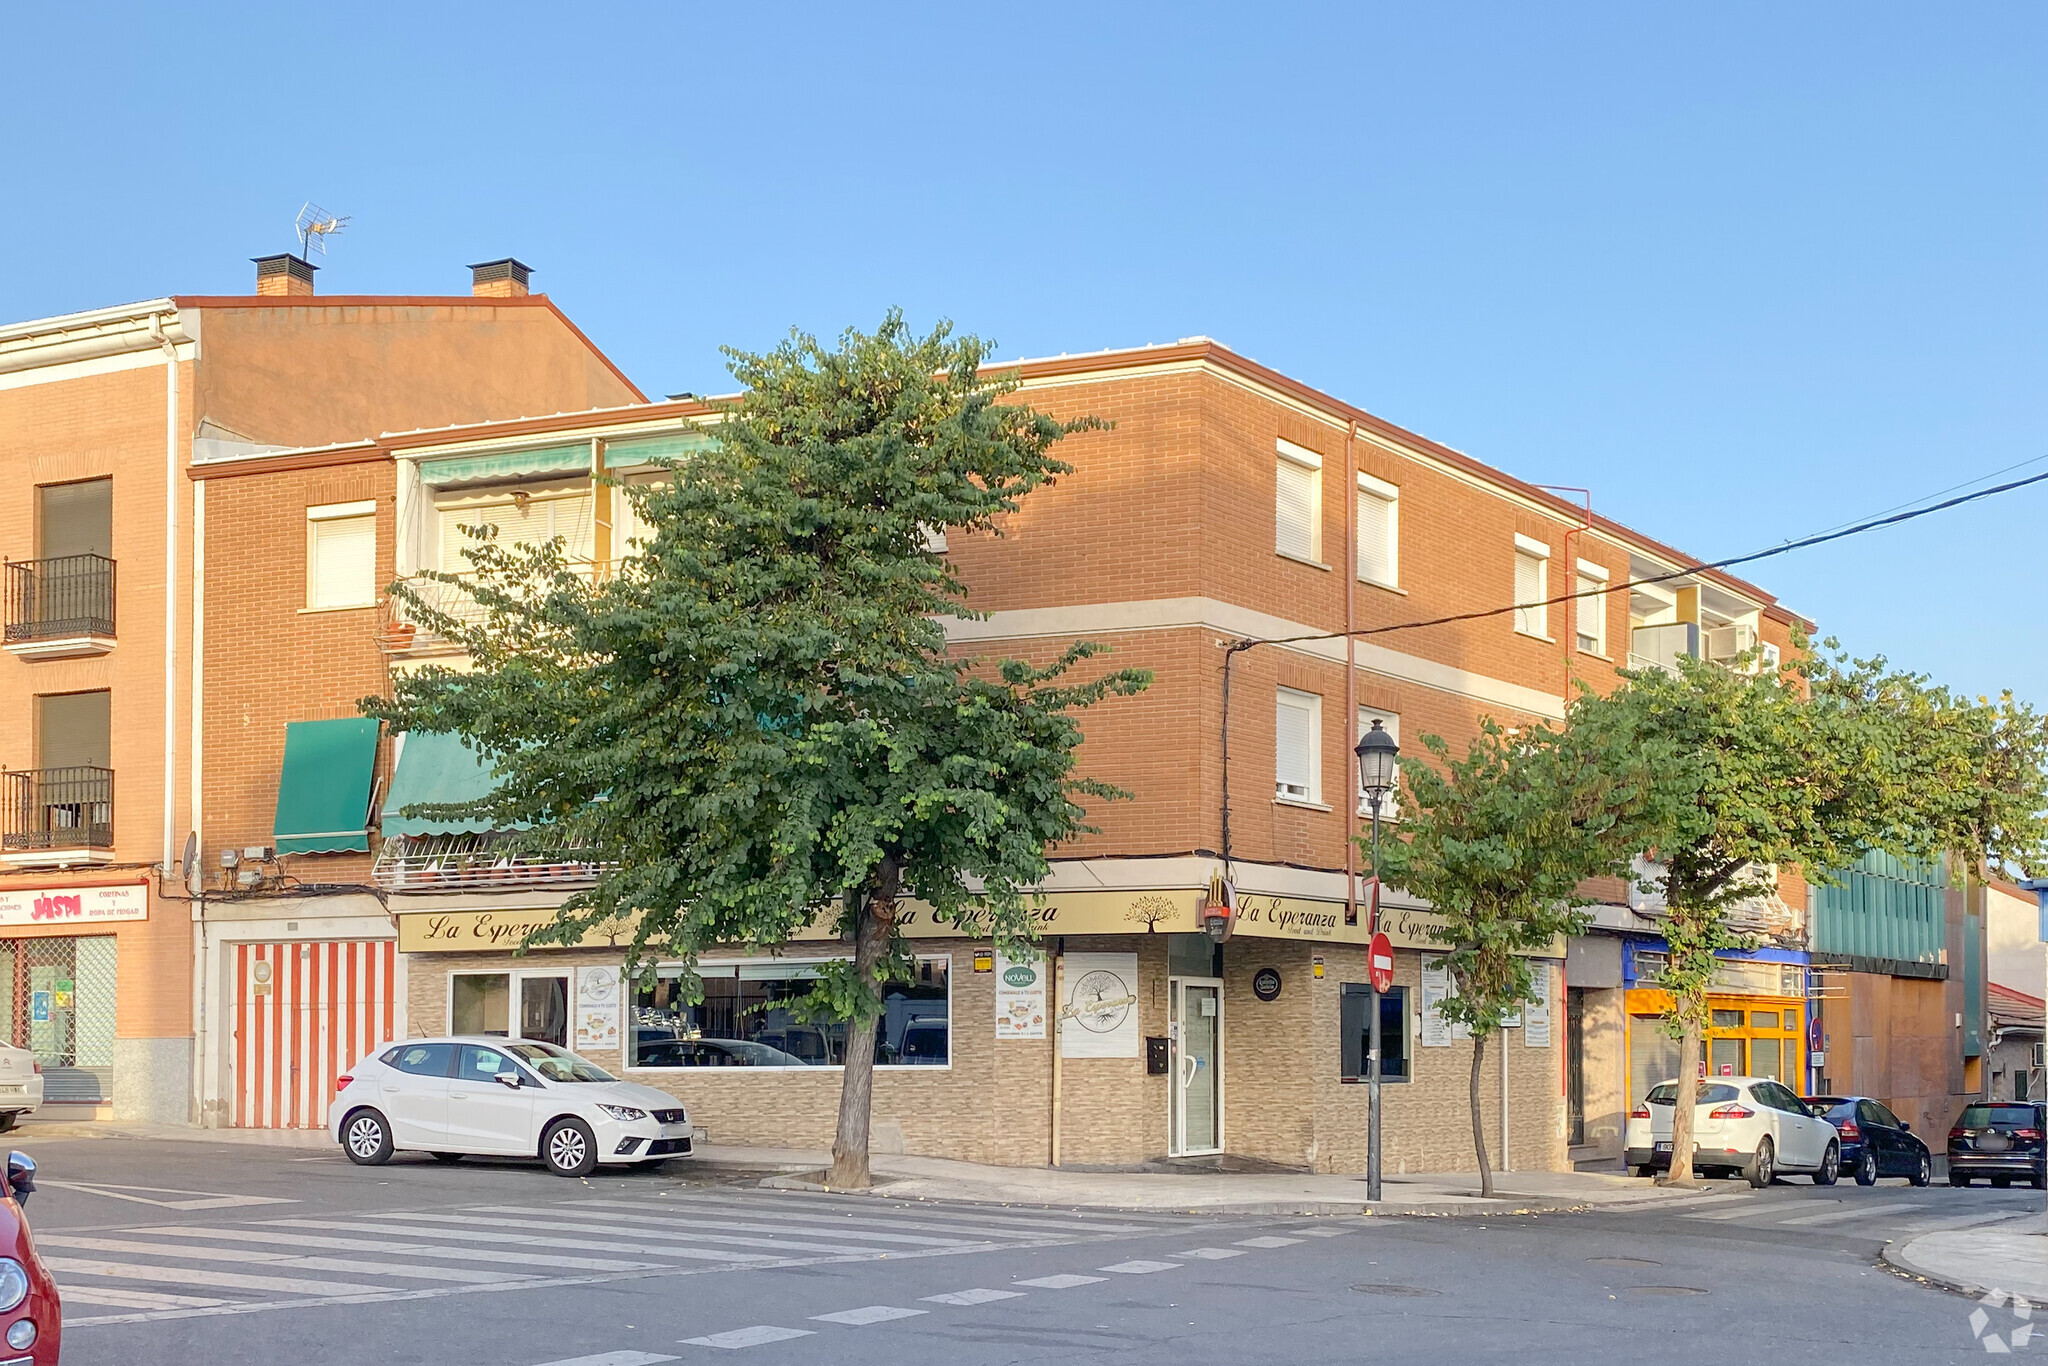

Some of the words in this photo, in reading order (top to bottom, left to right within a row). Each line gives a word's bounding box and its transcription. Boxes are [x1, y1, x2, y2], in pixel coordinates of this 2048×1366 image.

[1237, 896, 1260, 922] La
[1268, 897, 1337, 930] Esperanza
[1399, 911, 1453, 941] Esperan
[423, 915, 461, 939] La
[473, 914, 571, 943] Esperan
